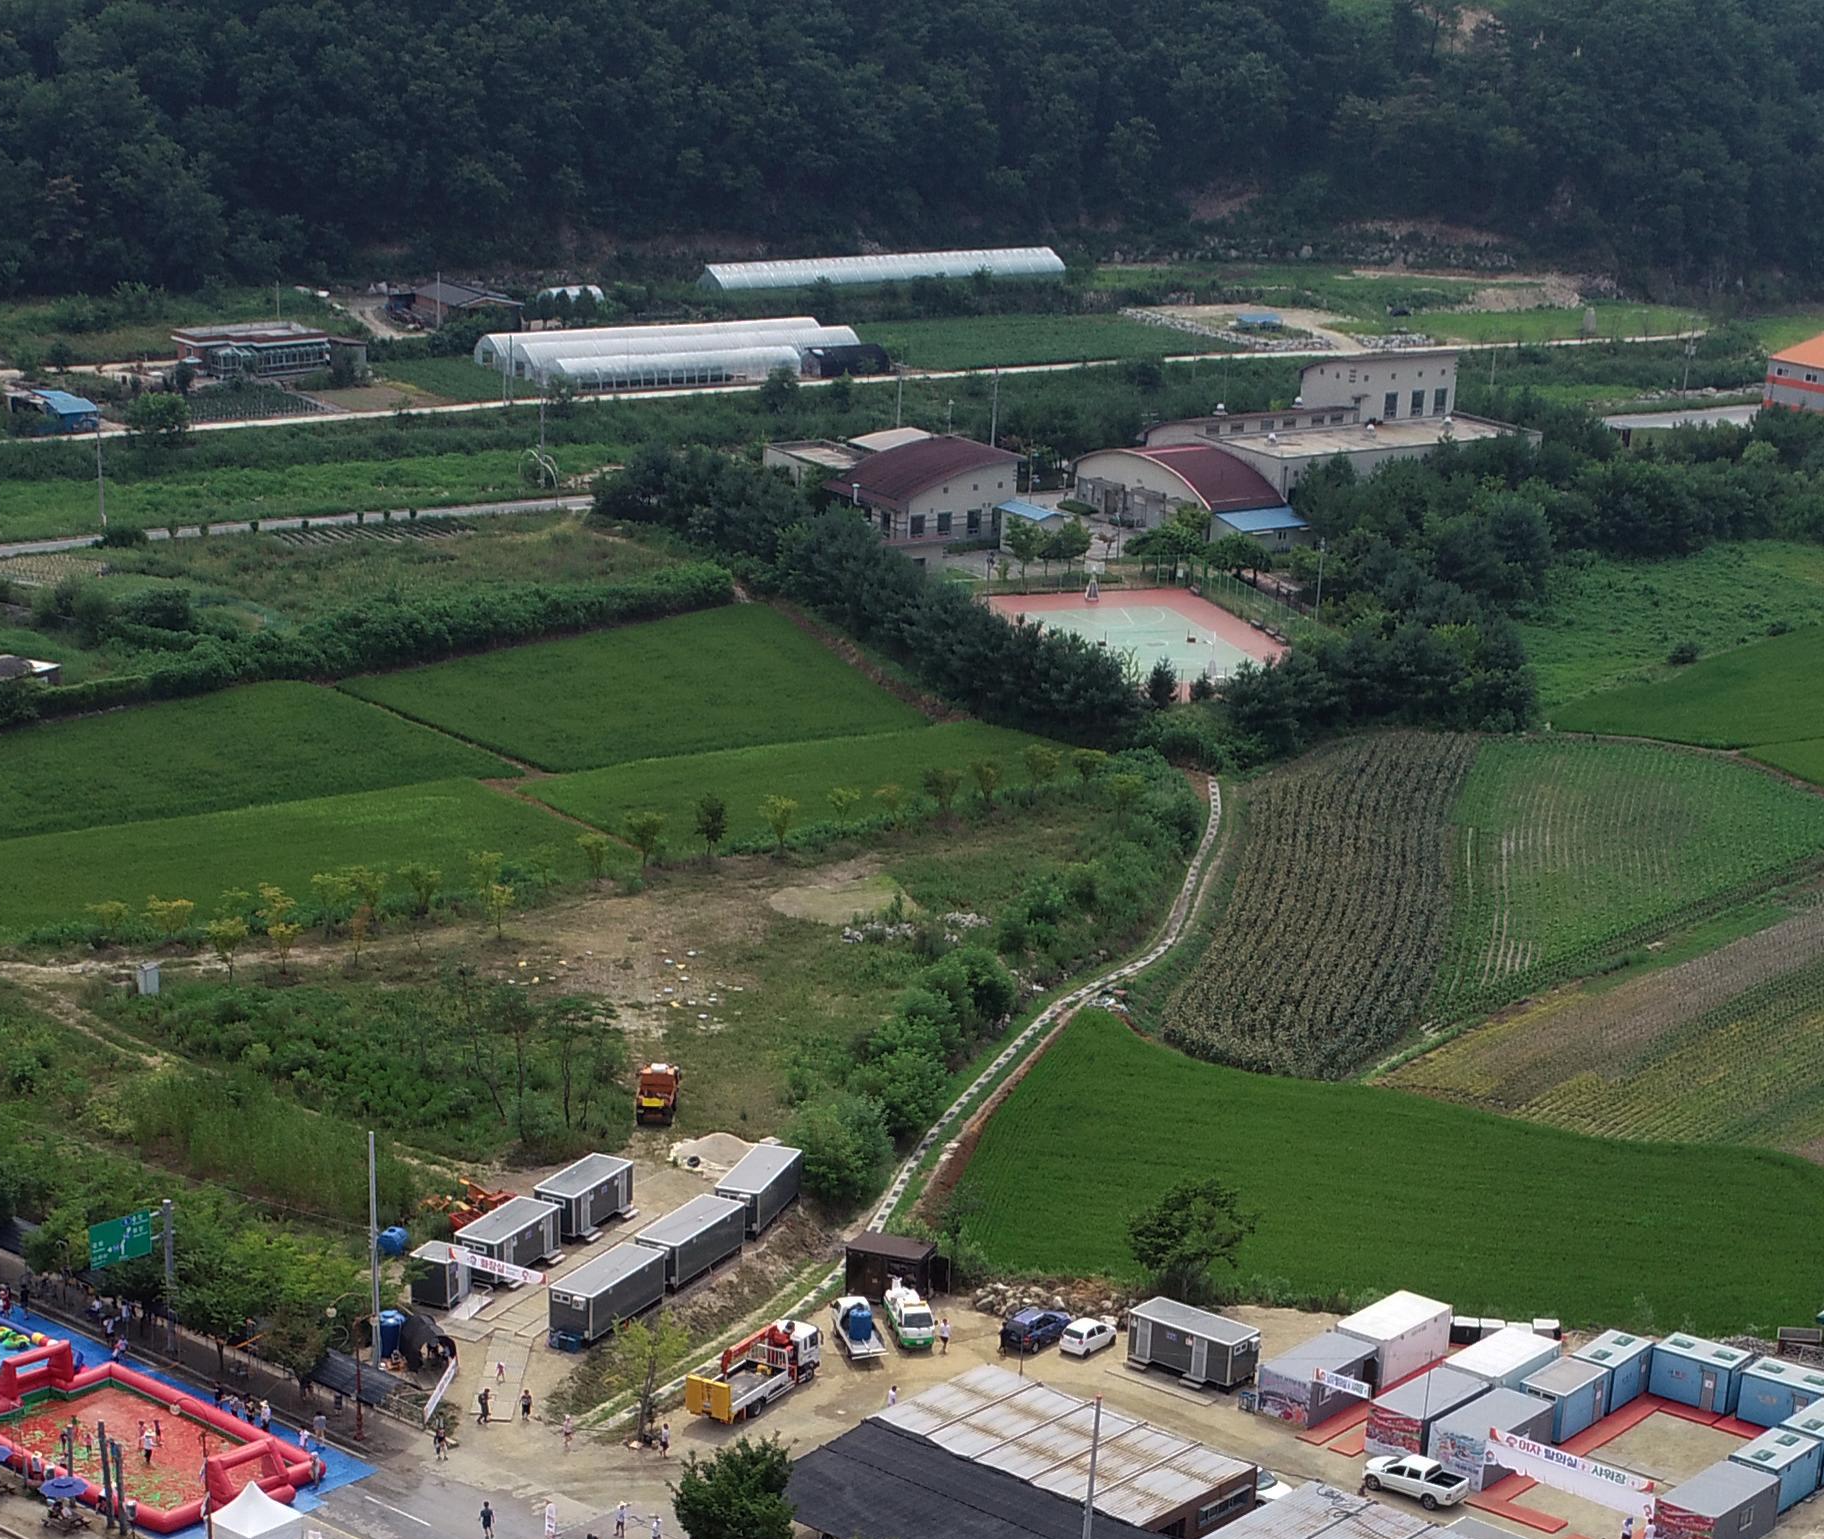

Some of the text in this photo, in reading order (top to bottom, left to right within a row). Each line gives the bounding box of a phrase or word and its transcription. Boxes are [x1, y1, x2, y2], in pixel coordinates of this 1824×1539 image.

[479, 1257, 505, 1275] 화장실
[1518, 1440, 1628, 1486] 여자 탈의실 샤워장
